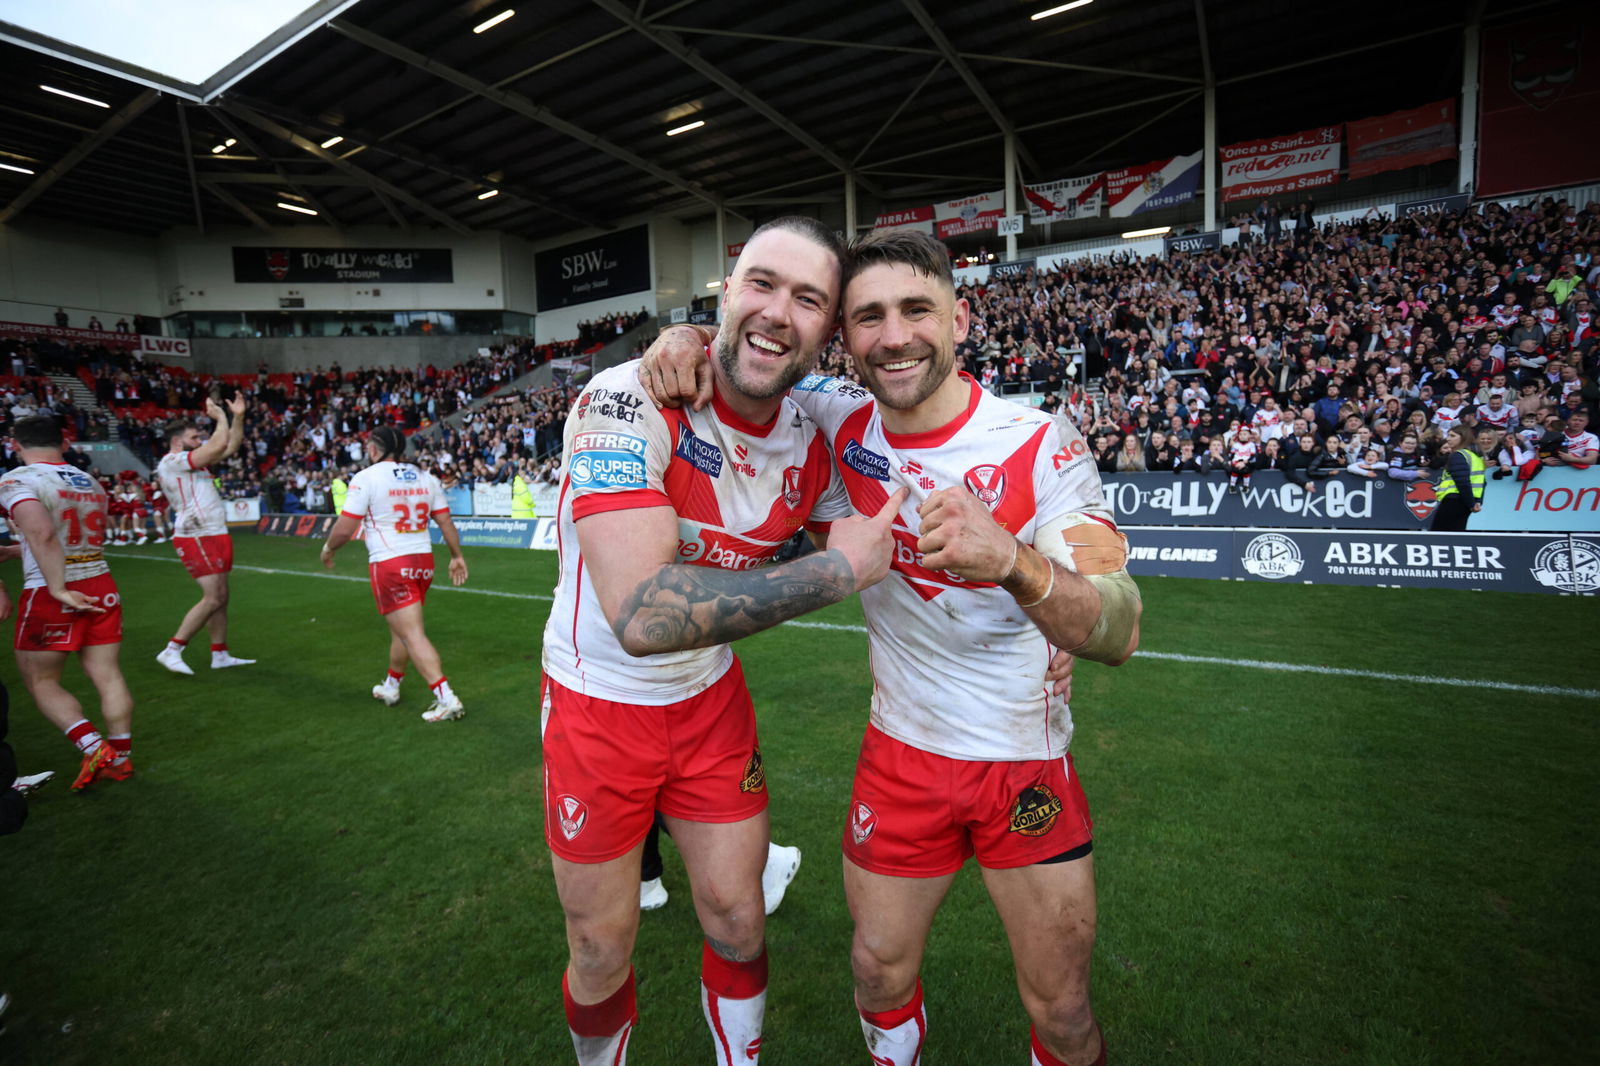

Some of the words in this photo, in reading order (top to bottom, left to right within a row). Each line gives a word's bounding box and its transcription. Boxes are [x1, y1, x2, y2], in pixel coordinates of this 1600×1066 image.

[1259, 144, 1268, 152] a
[1287, 179, 1295, 190] a
[1001, 218, 1020, 232] W5
[561, 248, 604, 279] SBW
[337, 270, 380, 279] STADIUM
[50, 328, 64, 336] TO
[145, 338, 188, 354] LWC
[575, 433, 643, 453] BETFRED
[855, 446, 889, 469] Kinaxia
[593, 459, 643, 474] SUPER
[854, 459, 889, 478] Logistics
[593, 472, 644, 484] LEAGUE
[392, 502, 430, 531] 23
[61, 508, 107, 547] 19
[1159, 547, 1218, 563] GAMES
[1323, 542, 1399, 566] ABK
[1405, 544, 1506, 569] BEER
[1259, 562, 1286, 573] ABK
[1327, 565, 1345, 575] 700
[1347, 566, 1377, 576] YEARS
[1379, 567, 1391, 576] OF
[1391, 568, 1439, 578] BAVARIAN
[1441, 570, 1503, 581] PERFECTION
[1555, 572, 1598, 585] ABK
[1013, 803, 1058, 828] GORILLA
